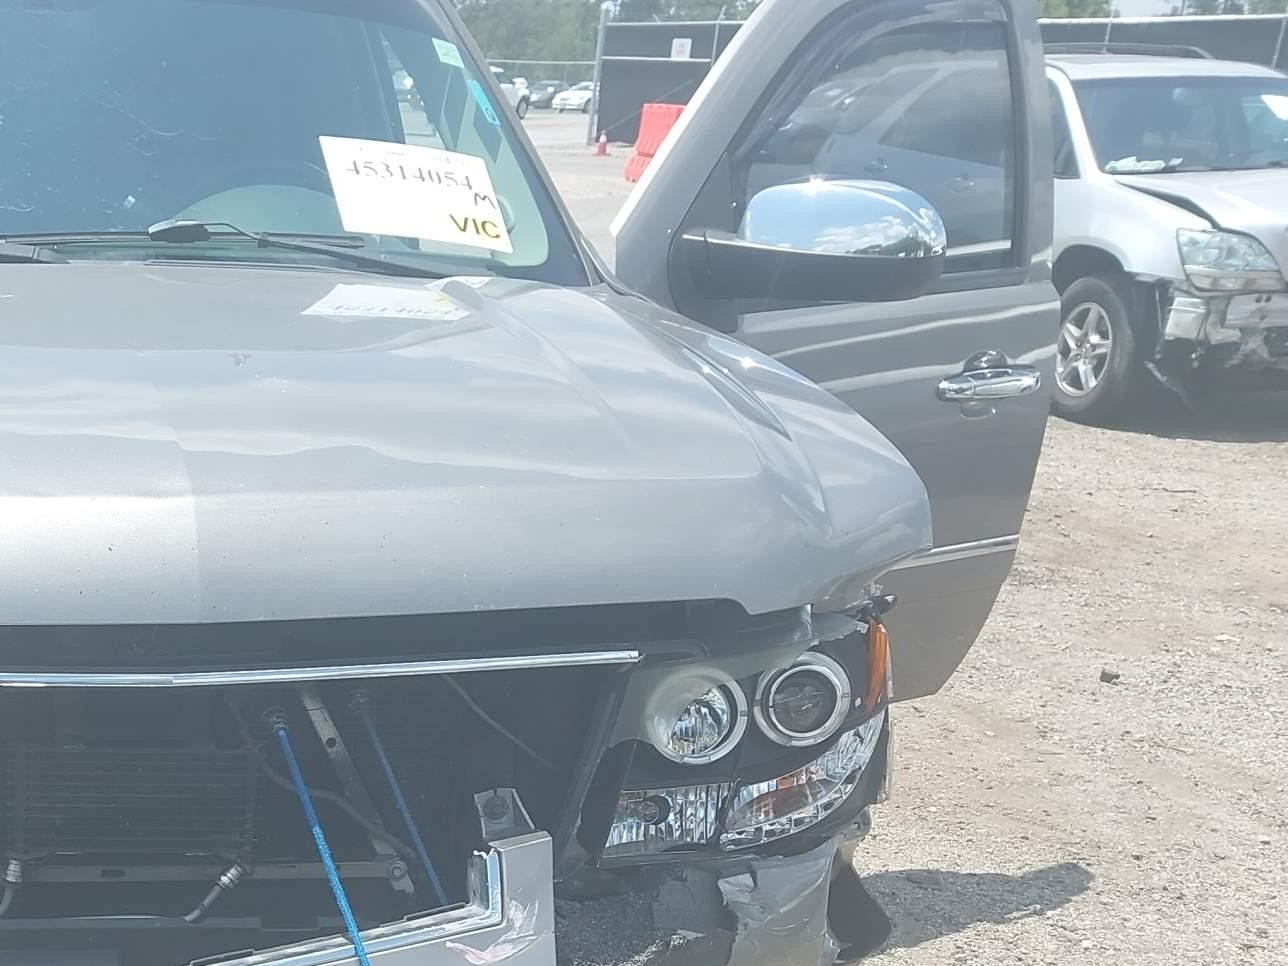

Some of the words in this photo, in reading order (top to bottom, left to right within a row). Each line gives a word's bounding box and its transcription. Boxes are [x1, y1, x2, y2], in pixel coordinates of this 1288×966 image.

[347, 159, 473, 191] 45314054
[474, 192, 496, 210] M
[449, 213, 501, 239] VIC
